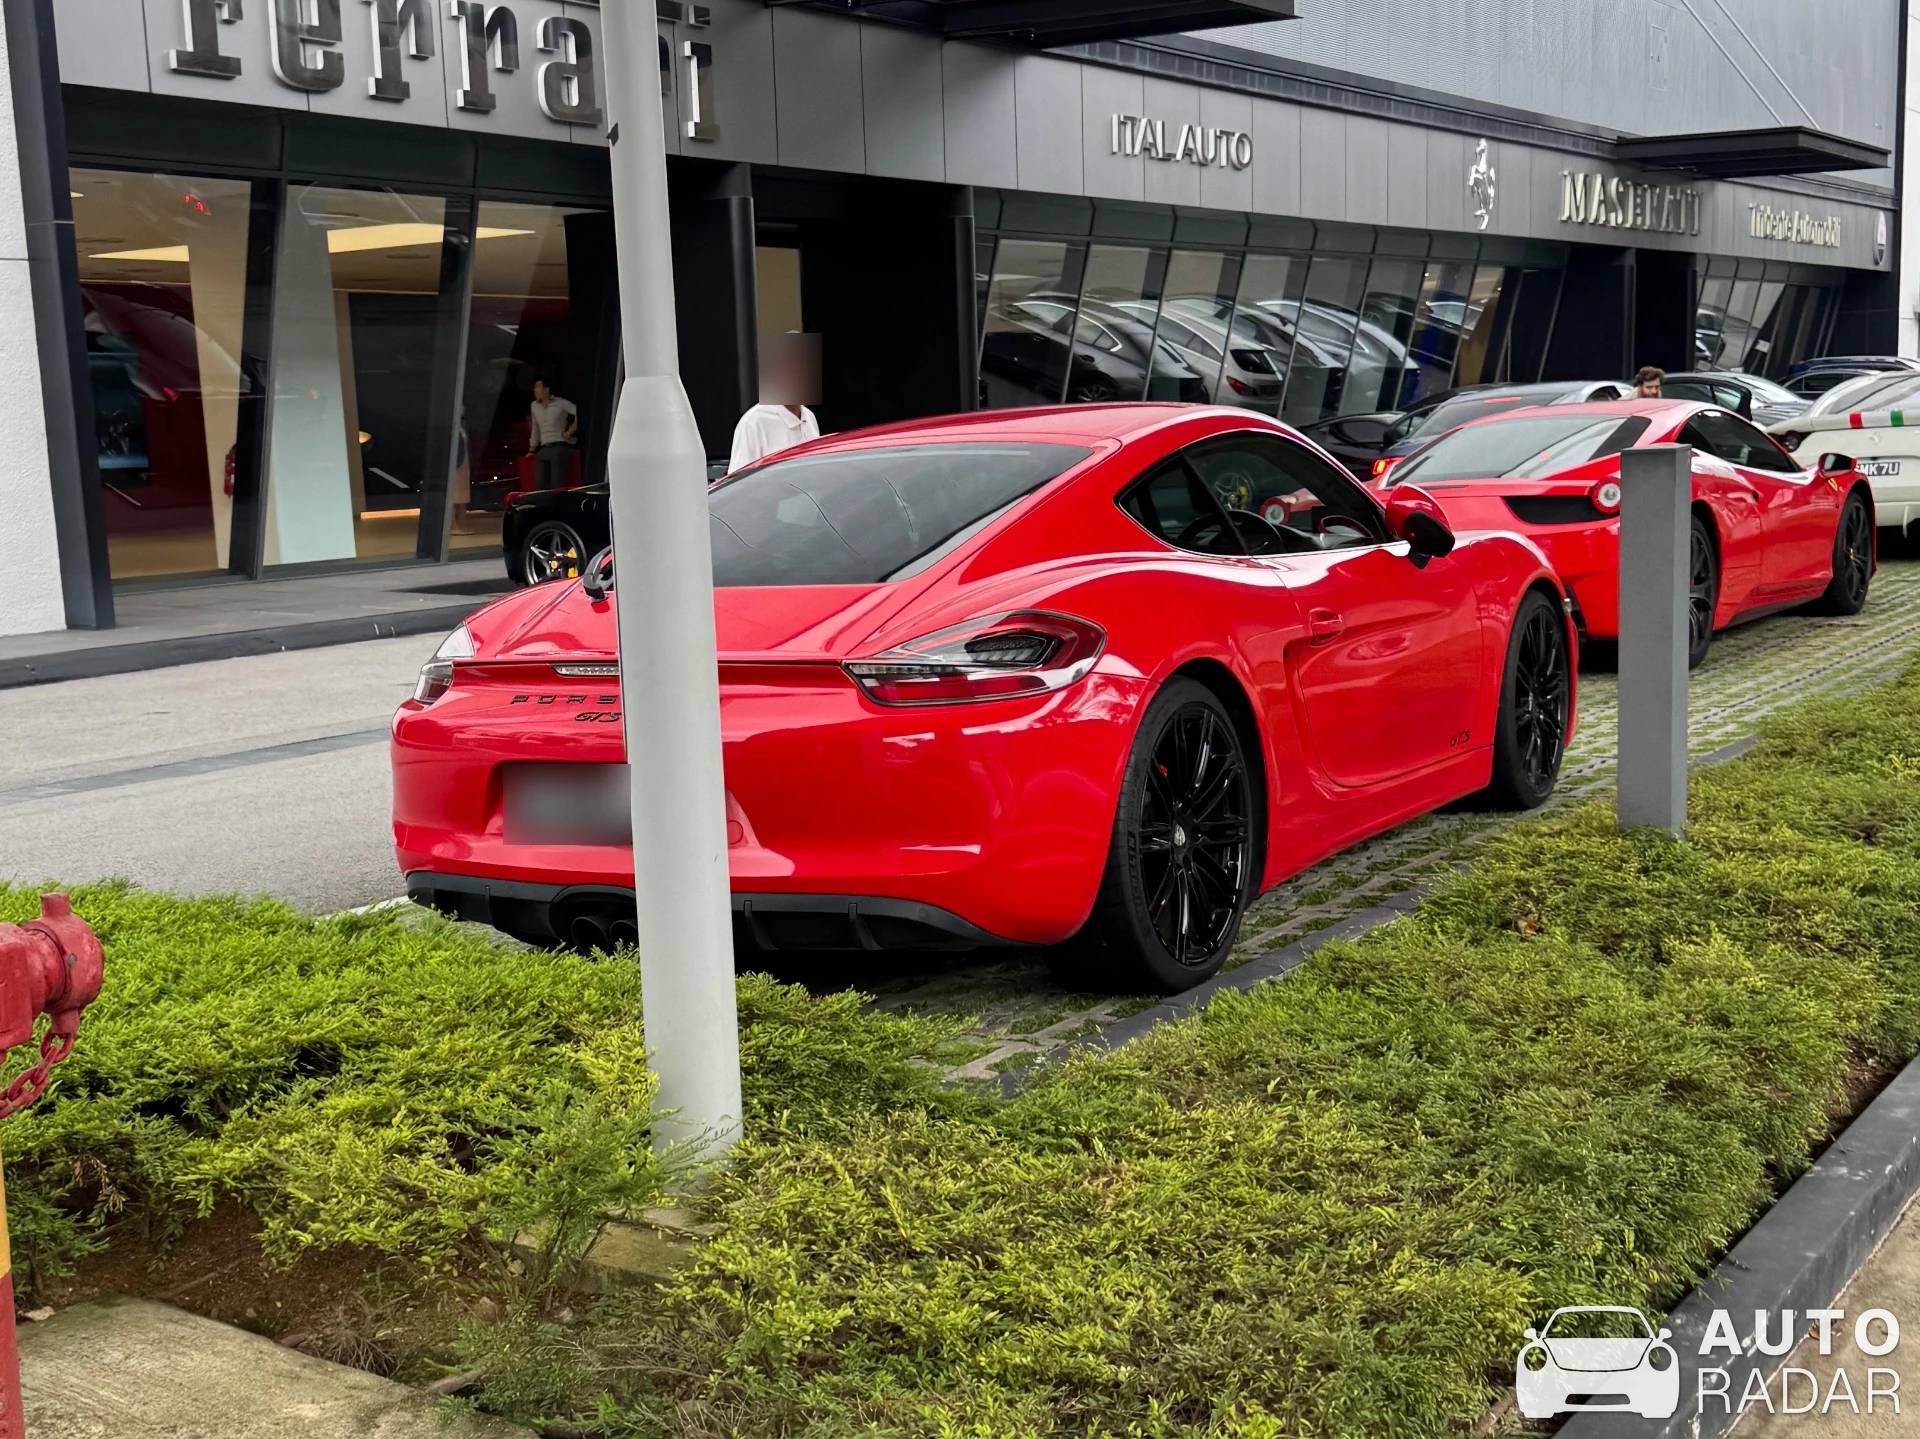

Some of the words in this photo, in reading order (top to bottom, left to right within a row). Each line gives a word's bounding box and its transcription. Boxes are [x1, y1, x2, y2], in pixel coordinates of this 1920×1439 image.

[168, 0, 721, 141] errai
[1558, 170, 1703, 236] MASERATI
[1857, 463, 1878, 475] MK
[511, 695, 618, 704] PORS
[574, 711, 622, 723] GTS
[1449, 729, 1471, 747] GTS
